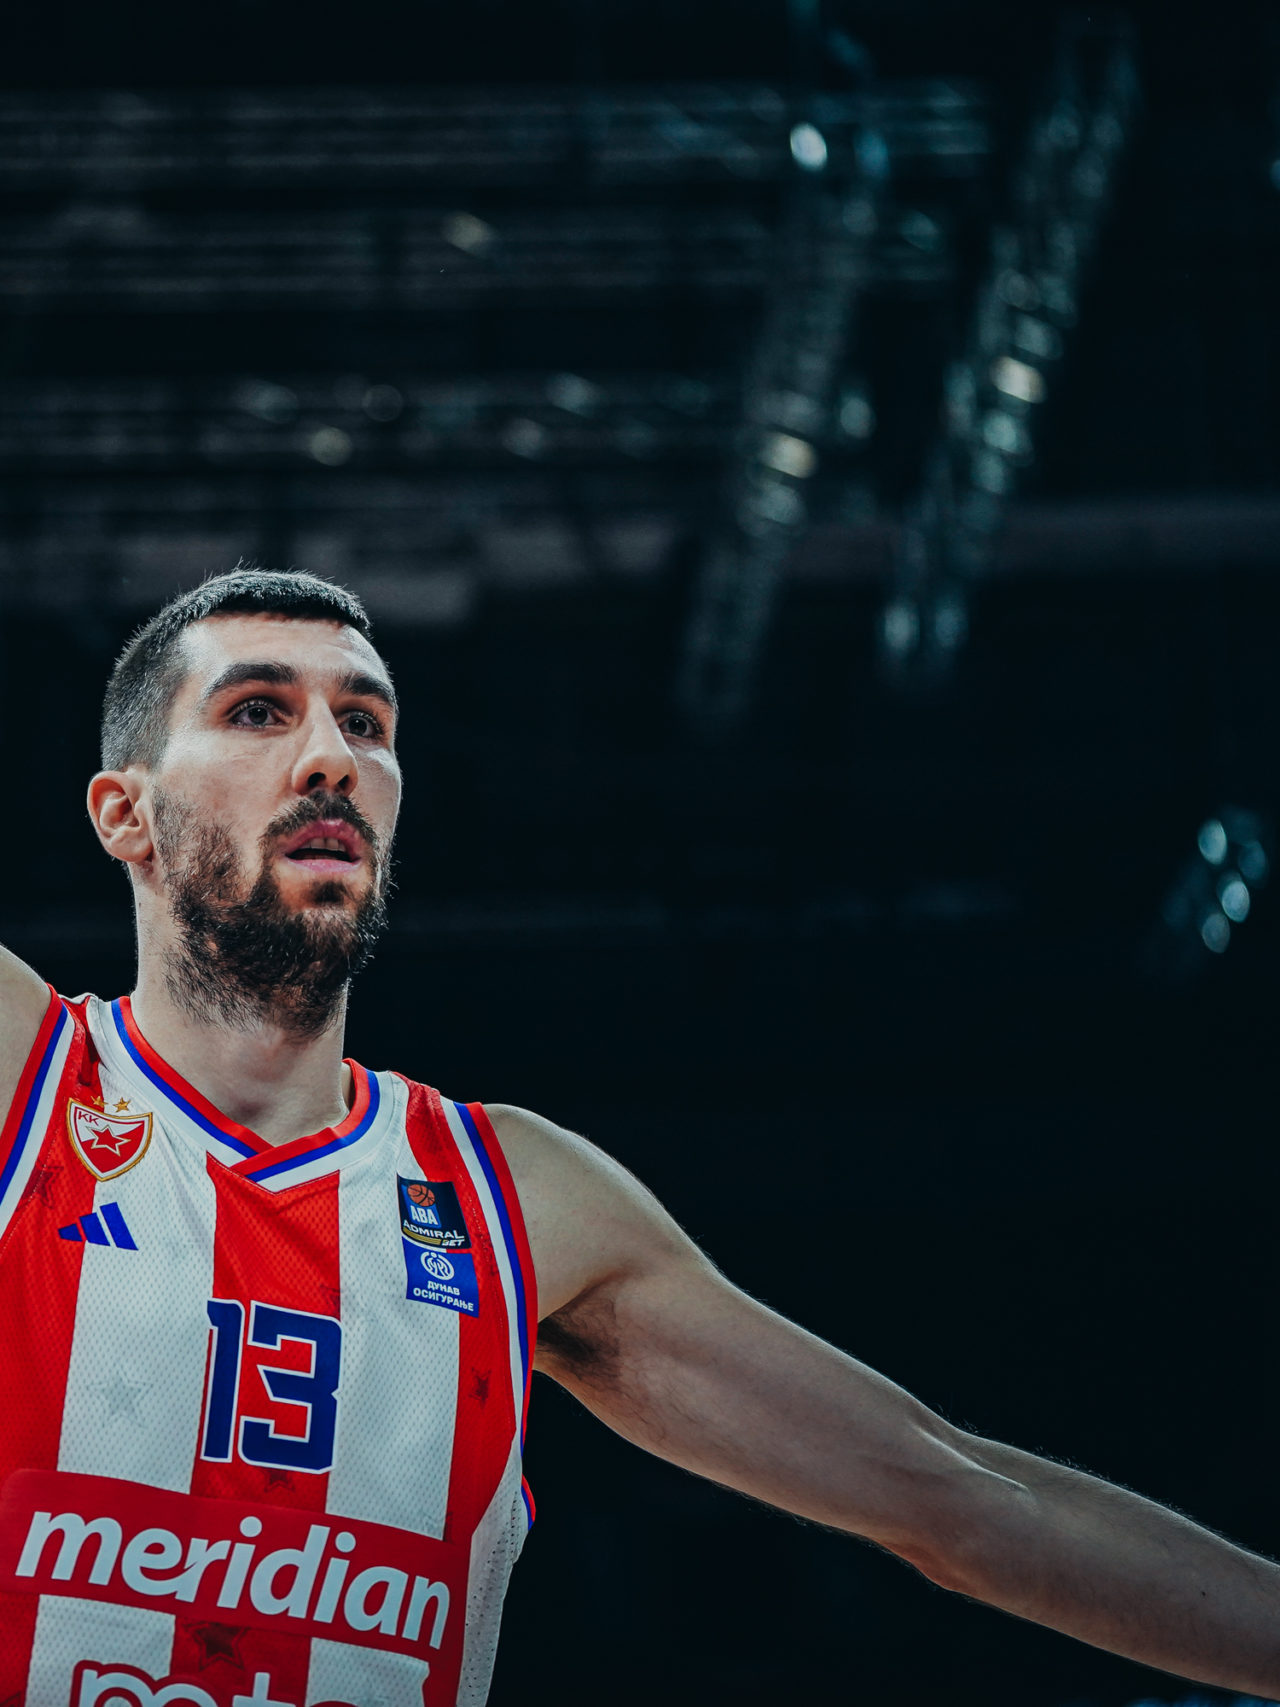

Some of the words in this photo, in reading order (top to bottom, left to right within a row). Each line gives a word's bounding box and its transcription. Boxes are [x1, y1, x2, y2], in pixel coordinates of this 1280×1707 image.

[78, 1110, 100, 1126] KK
[410, 1204, 439, 1226] ABA
[403, 1219, 465, 1240] ADMIRAL
[441, 1238, 466, 1247] BET
[427, 1280, 460, 1296] ДУНАВ
[413, 1287, 475, 1312] ОСИГУРАЊЕ
[200, 1297, 343, 1475] 13
[15, 1511, 450, 1650] meridian
